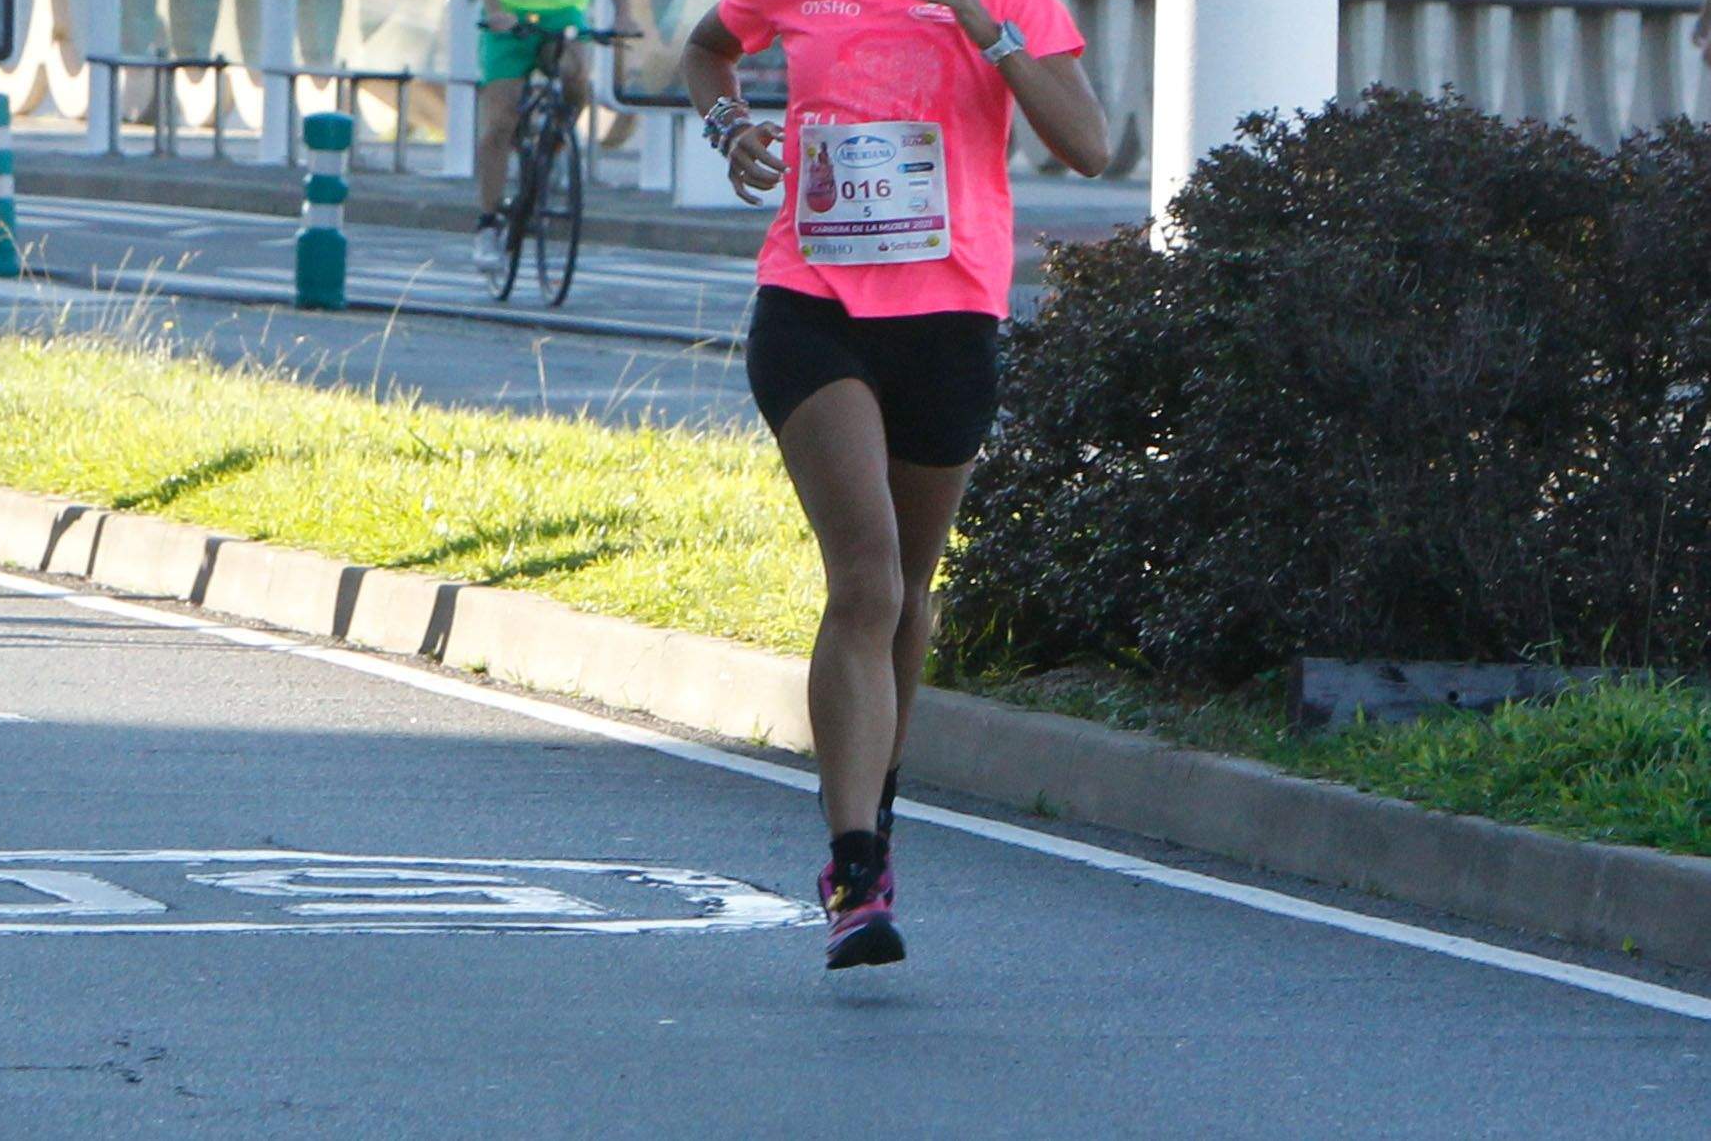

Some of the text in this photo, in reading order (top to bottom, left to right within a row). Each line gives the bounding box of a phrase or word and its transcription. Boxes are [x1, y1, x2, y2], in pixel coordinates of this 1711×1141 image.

[800, 0, 861, 17] OYSHO
[841, 179, 892, 200] 016
[863, 206, 873, 218] 5
[865, 223, 878, 232] LA
[890, 239, 928, 252] Santand
